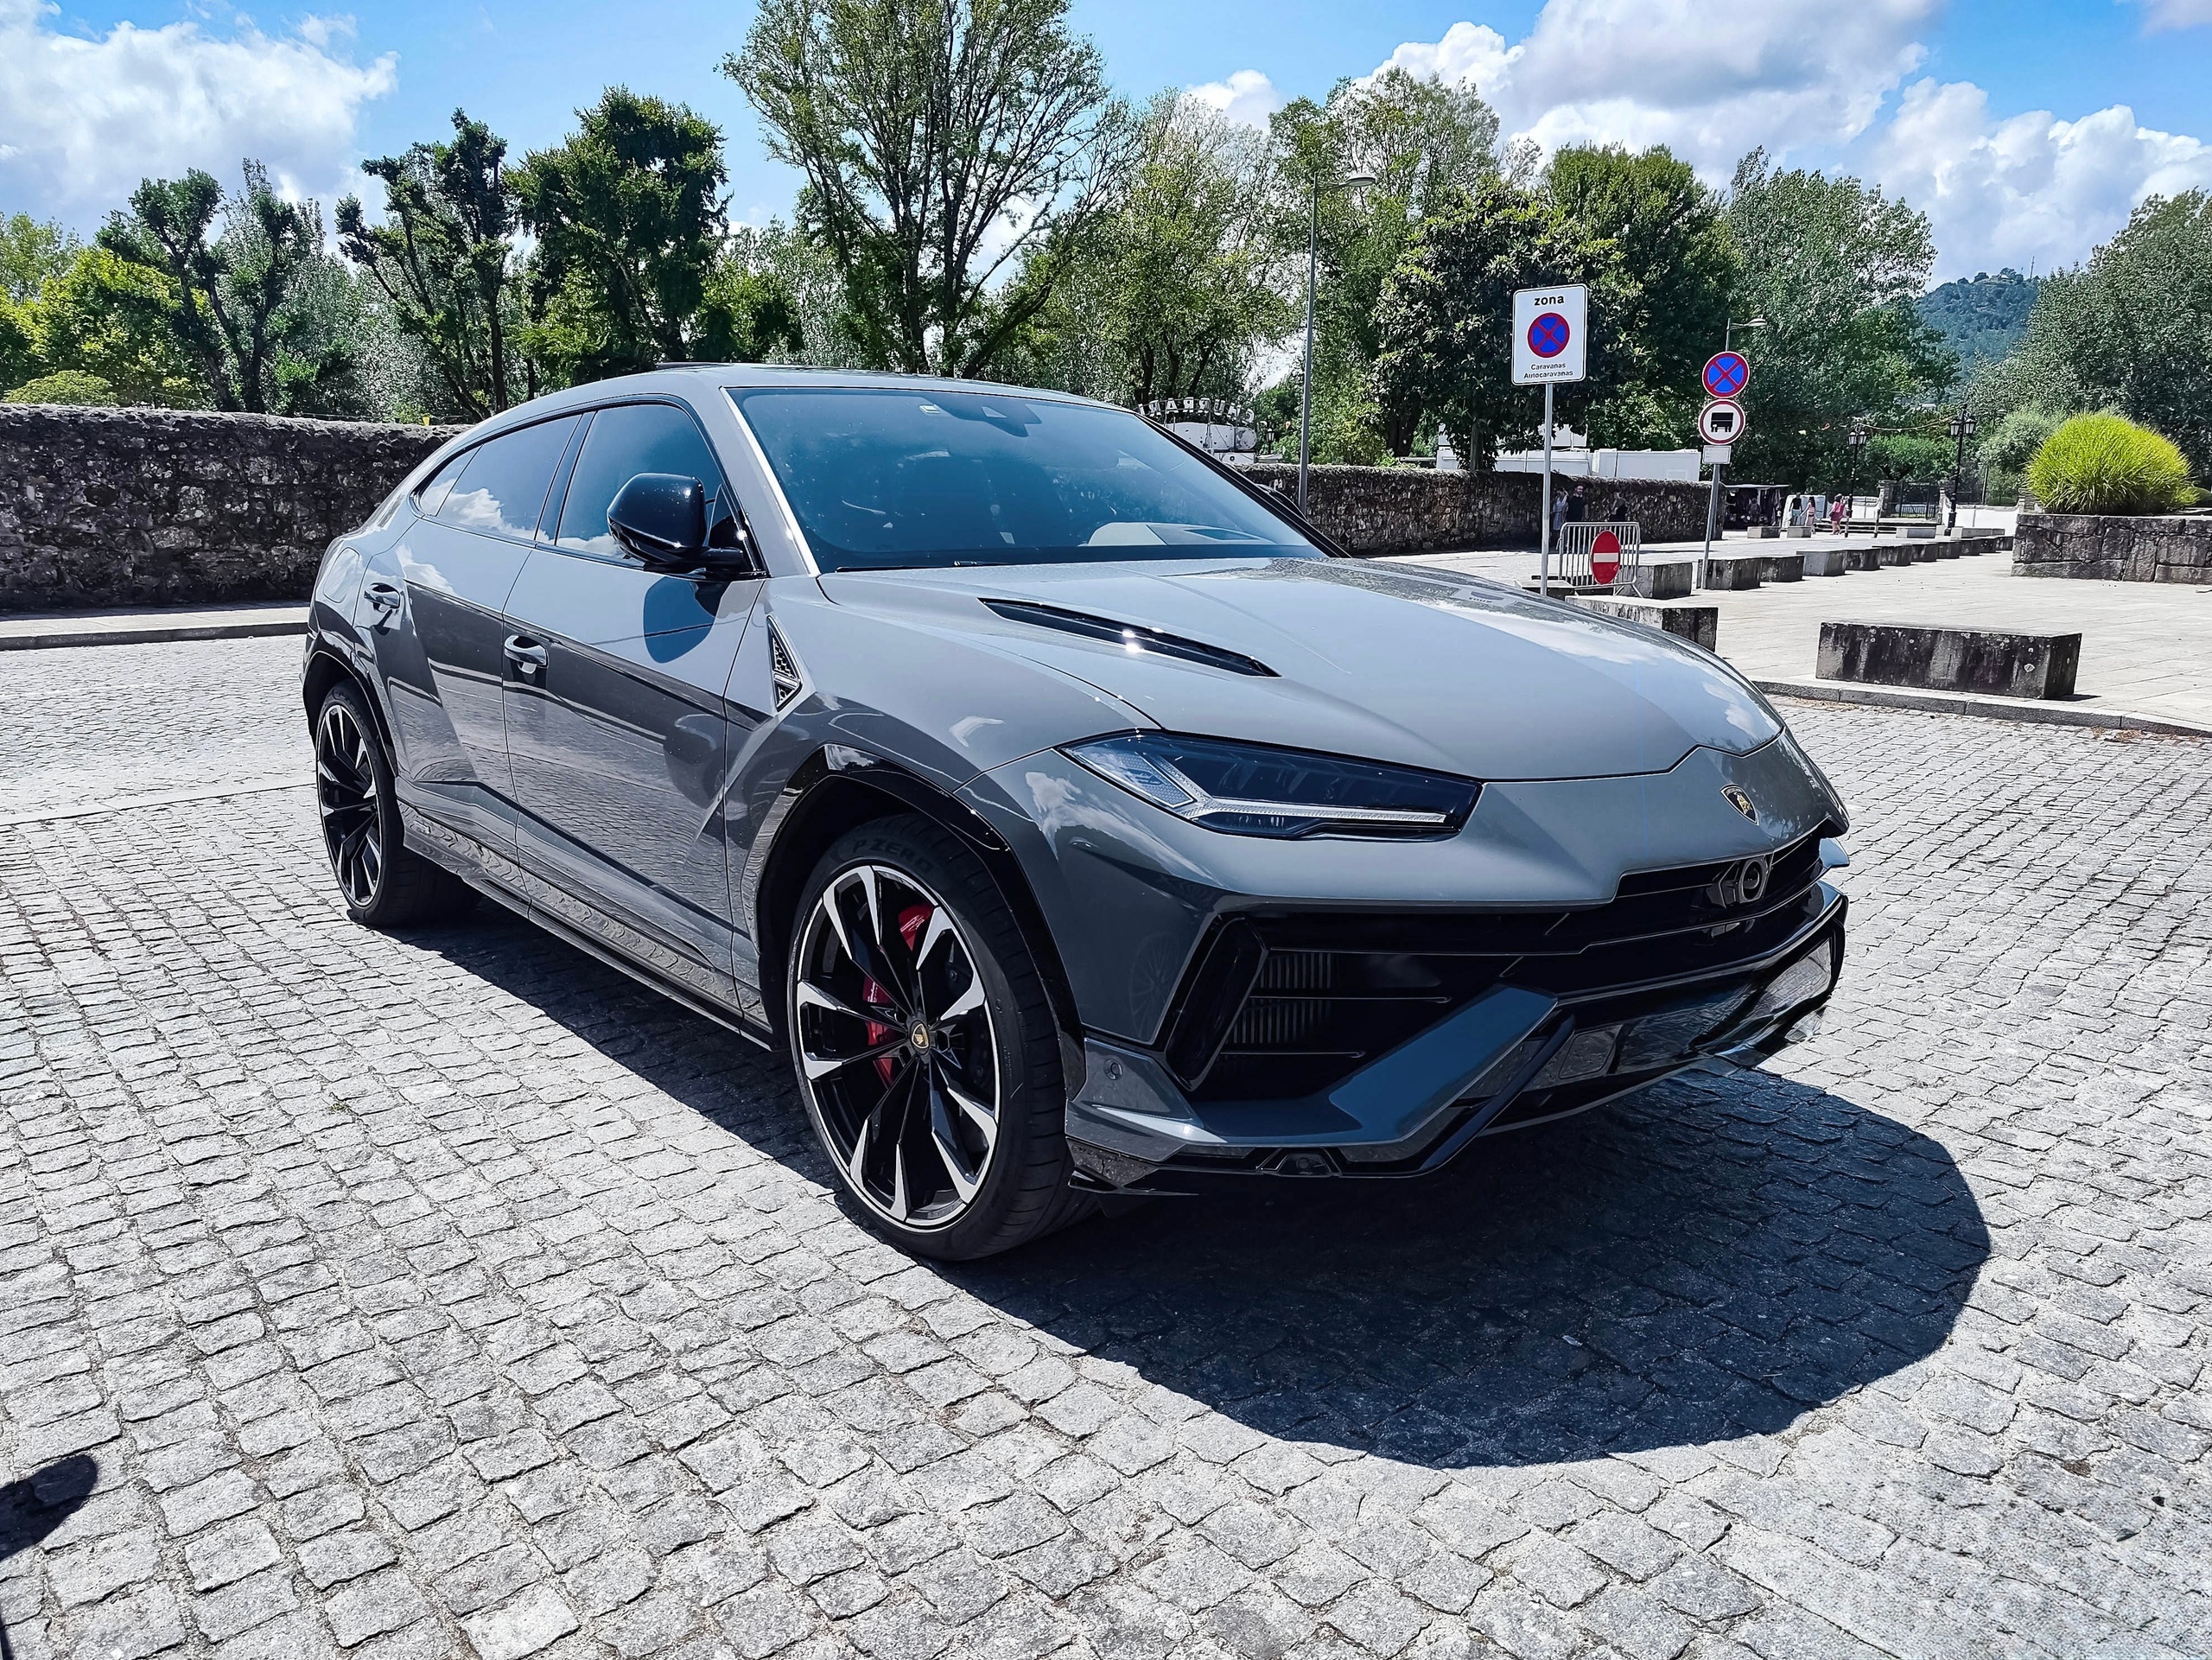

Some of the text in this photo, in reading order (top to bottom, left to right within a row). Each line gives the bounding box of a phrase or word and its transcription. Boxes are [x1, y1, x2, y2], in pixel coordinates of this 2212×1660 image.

[1534, 296, 1565, 306] zona
[1530, 362, 1567, 371] Caravanas
[1523, 371, 1573, 379] Autocaravanas
